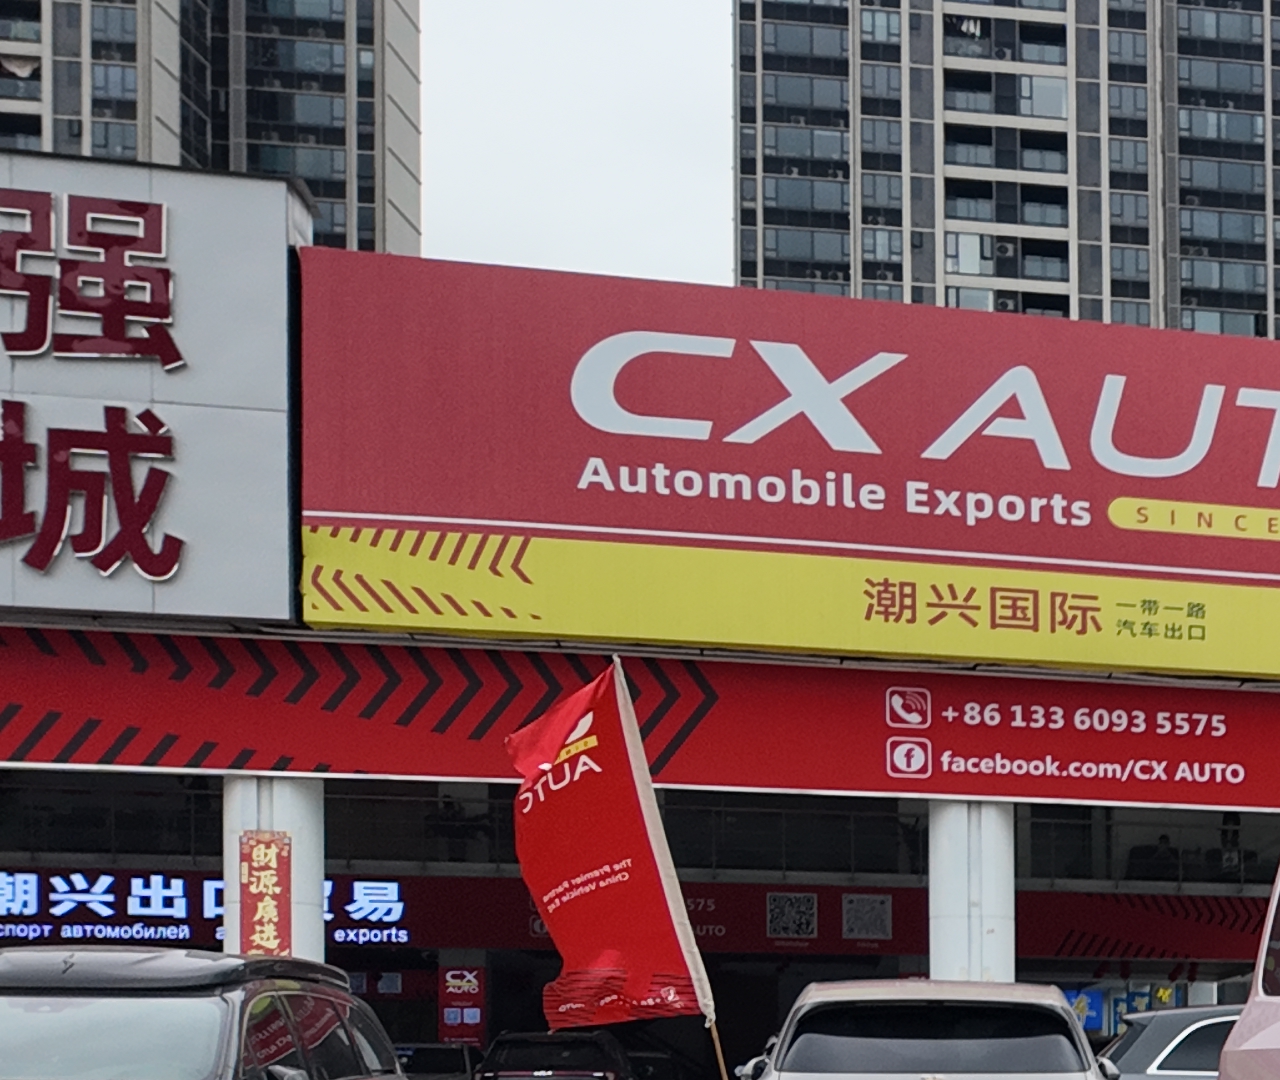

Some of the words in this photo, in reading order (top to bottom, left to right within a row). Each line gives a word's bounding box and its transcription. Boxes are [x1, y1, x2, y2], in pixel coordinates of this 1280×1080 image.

[570, 331, 908, 454] CX
[576, 457, 886, 511] Automobile
[906, 480, 1092, 526] Exports
[1135, 505, 1280, 535] SINCE
[863, 577, 1103, 636] 潮兴国际
[1115, 598, 1207, 620] 一带一路
[1115, 619, 1207, 642] 汽车出口
[941, 702, 1001, 727] +86
[1009, 704, 1066, 730] 133
[1073, 707, 1147, 733] 6093
[1155, 711, 1228, 737] 5575
[940, 750, 1168, 782] facebook.com/CX
[1175, 761, 1246, 784] AUTO
[61, 922, 191, 941] автомобилей
[334, 926, 409, 945] exports
[445, 970, 479, 986] CX
